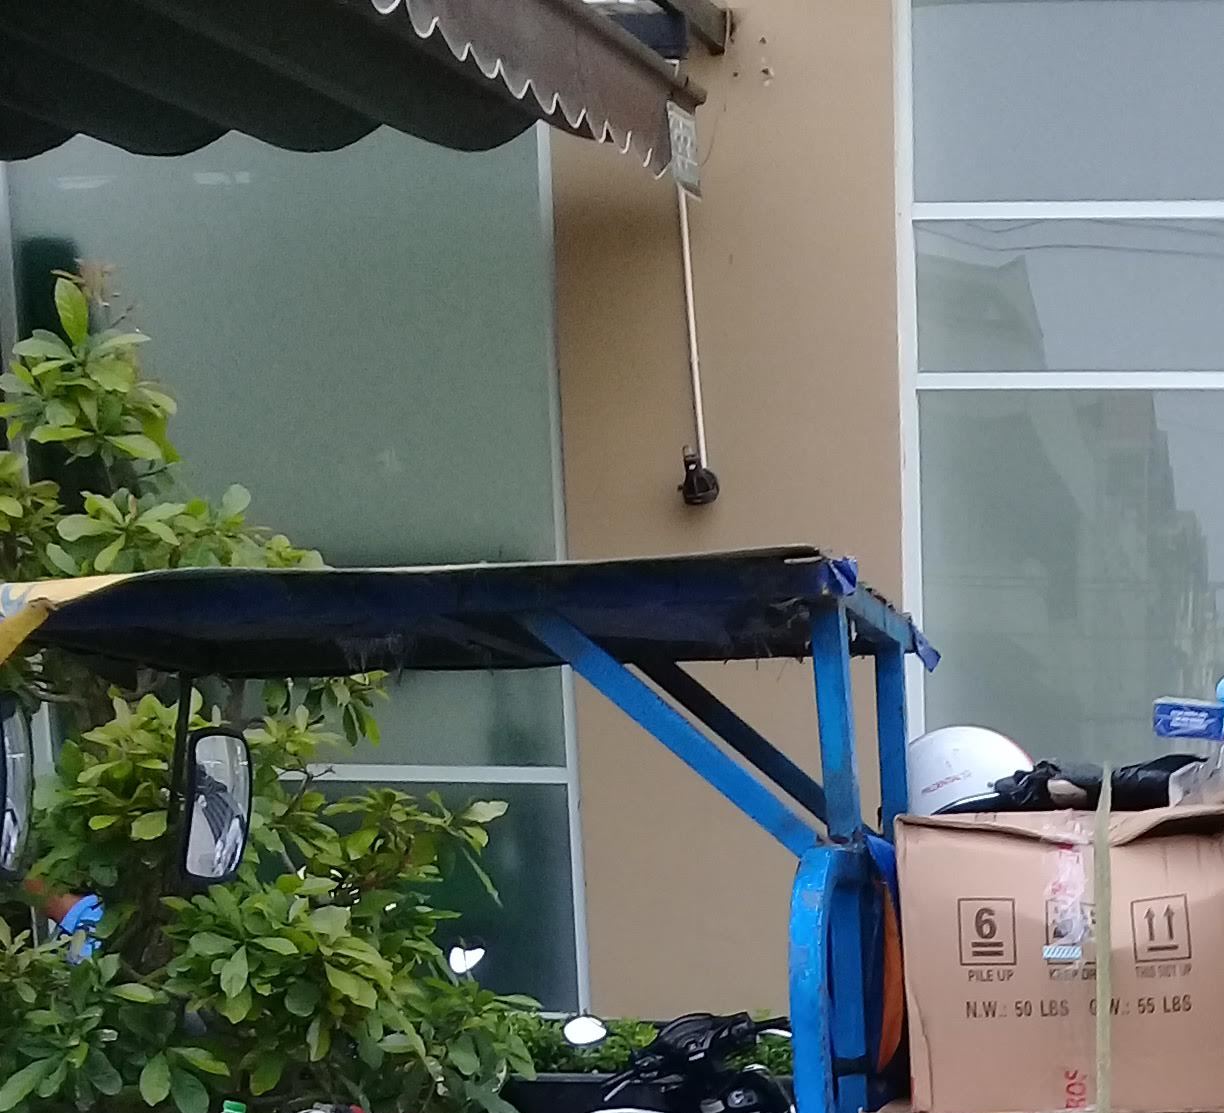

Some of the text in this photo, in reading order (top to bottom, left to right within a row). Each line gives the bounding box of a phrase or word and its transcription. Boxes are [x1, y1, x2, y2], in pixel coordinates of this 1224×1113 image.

[974, 907, 997, 939] 6
[968, 968, 1015, 982] PILE UP
[1014, 1000, 1033, 1017] 50
[1040, 1000, 1070, 1017] LBS
[1137, 997, 1156, 1014] 55
[1163, 994, 1192, 1013] LBS
